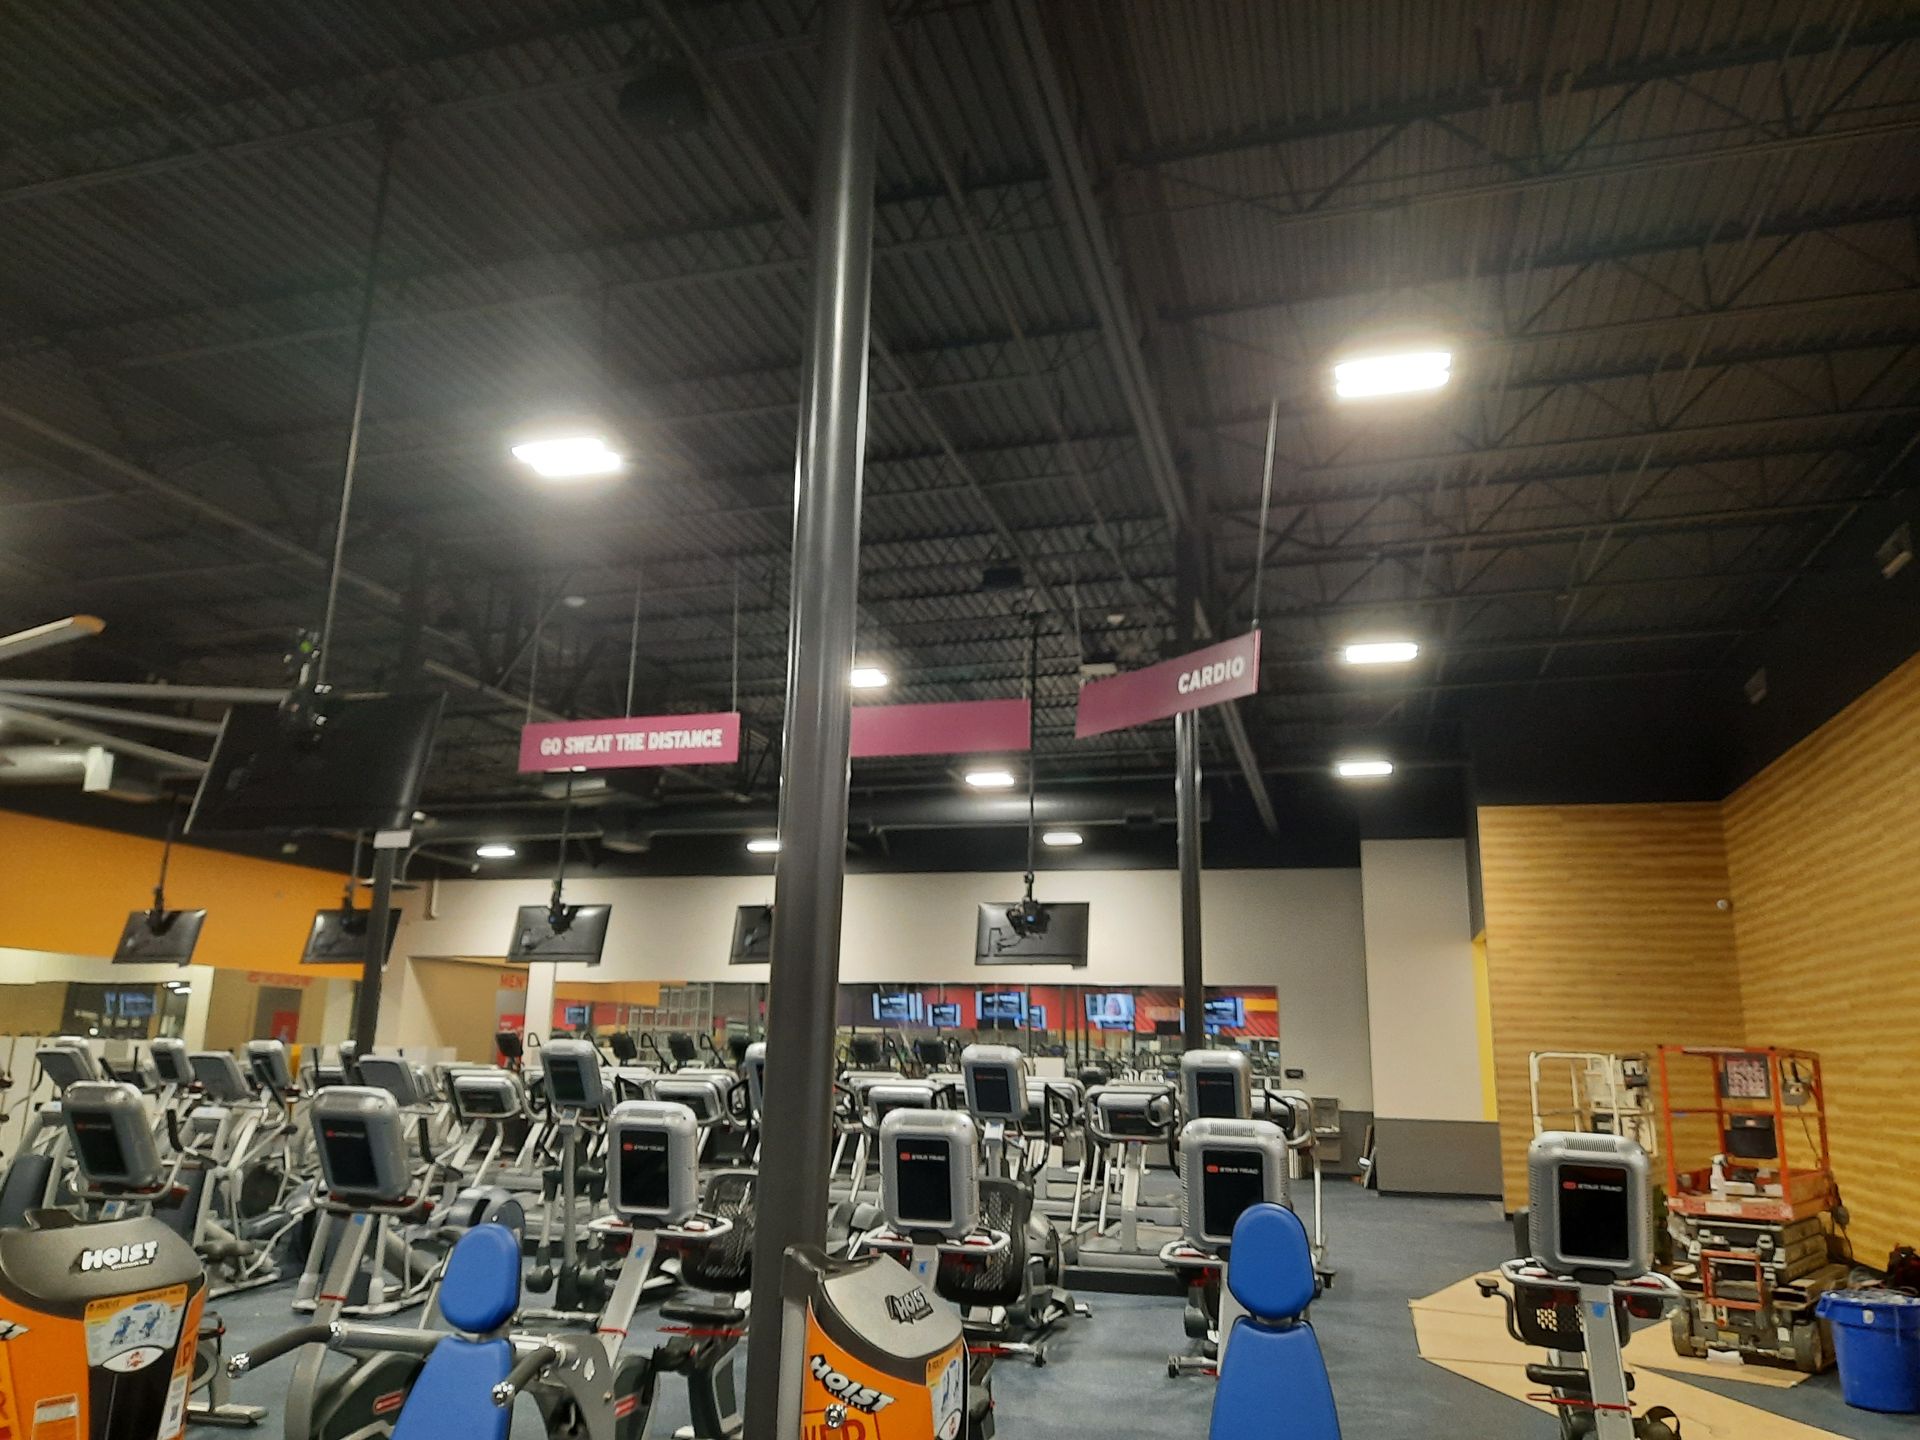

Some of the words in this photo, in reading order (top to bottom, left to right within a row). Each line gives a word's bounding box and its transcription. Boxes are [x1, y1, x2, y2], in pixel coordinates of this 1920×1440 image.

[1178, 656, 1244, 694] CARDIO
[541, 737, 562, 755] GO
[564, 735, 613, 755] SWEAT
[616, 733, 645, 751] THE
[648, 729, 723, 749] DISTANCE
[81, 1240, 157, 1271] HOIST
[810, 1356, 895, 1412] HOIST
